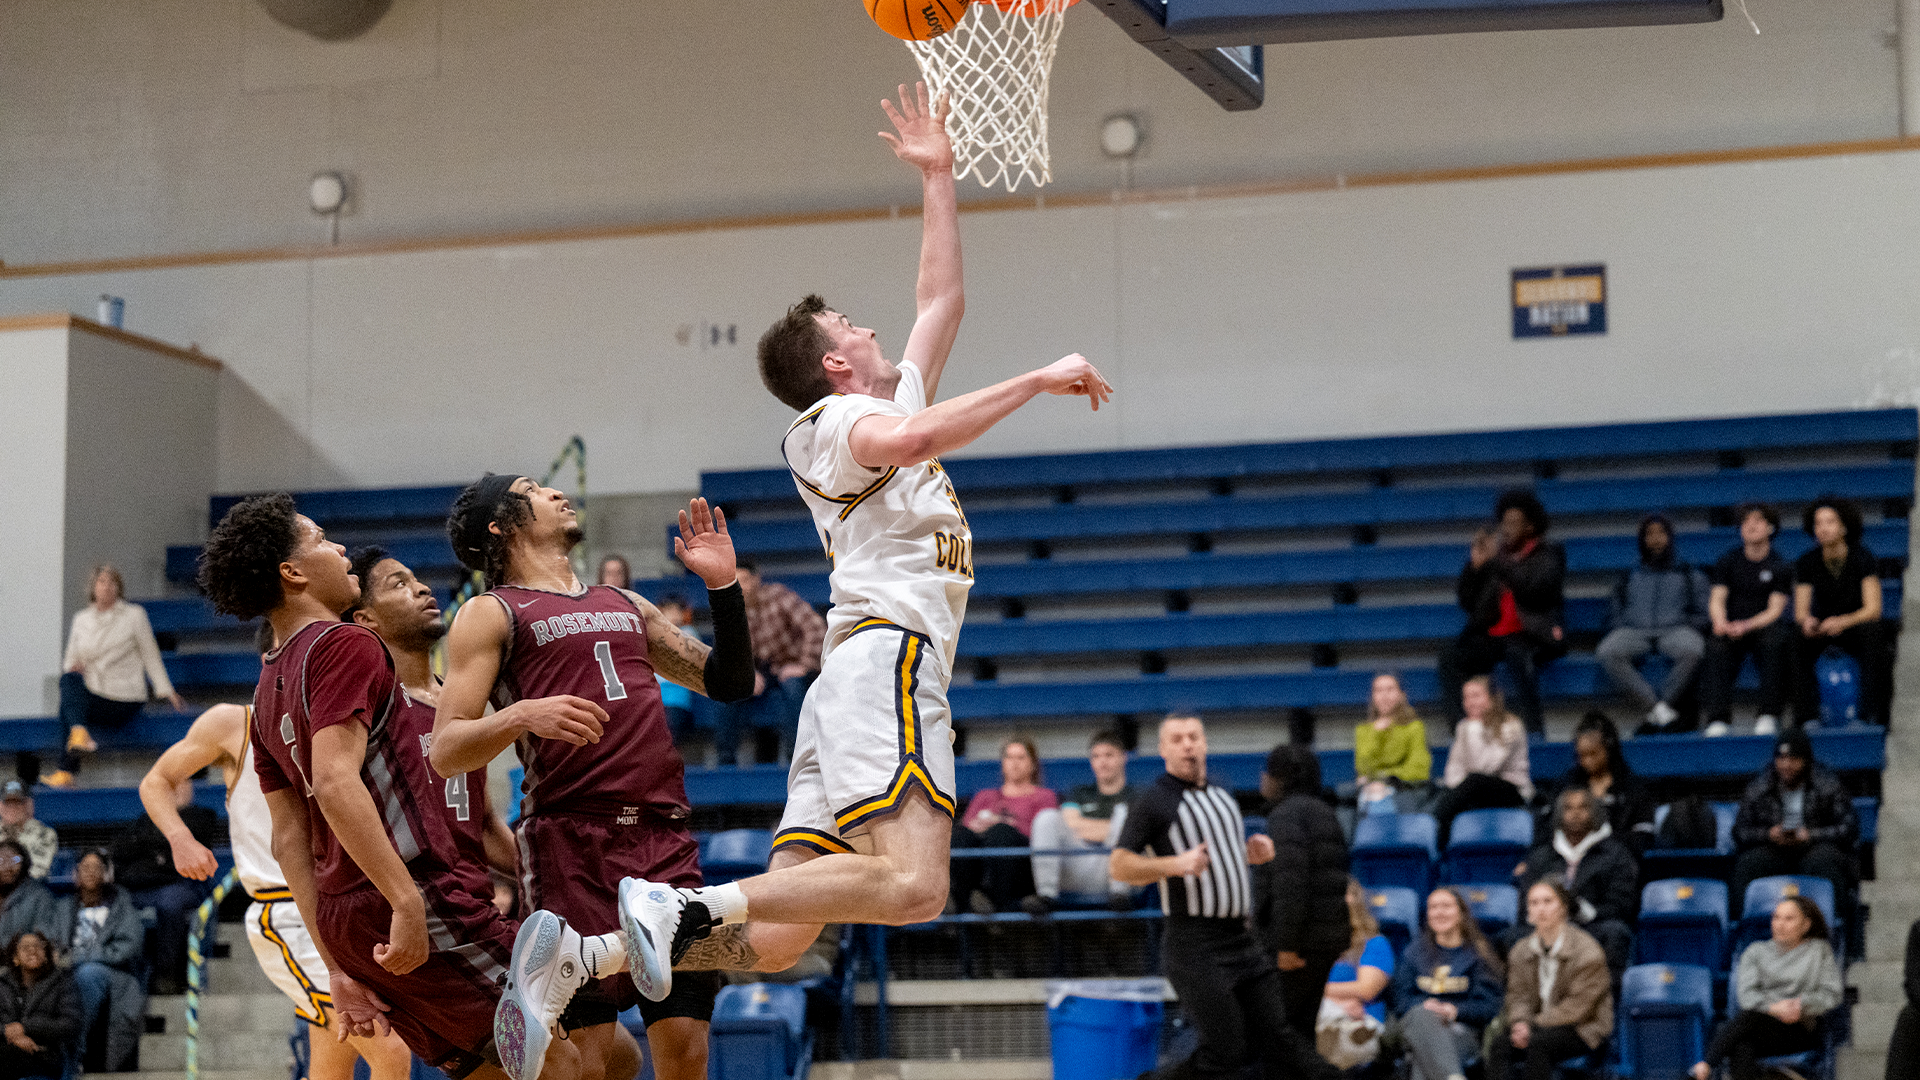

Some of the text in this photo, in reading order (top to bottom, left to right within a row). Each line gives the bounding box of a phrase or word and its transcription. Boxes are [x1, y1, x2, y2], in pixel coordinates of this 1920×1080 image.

[531, 612, 643, 646] ROSEMONT
[594, 641, 627, 701] 1
[616, 816, 639, 825] MONT
[622, 807, 639, 815] THE
